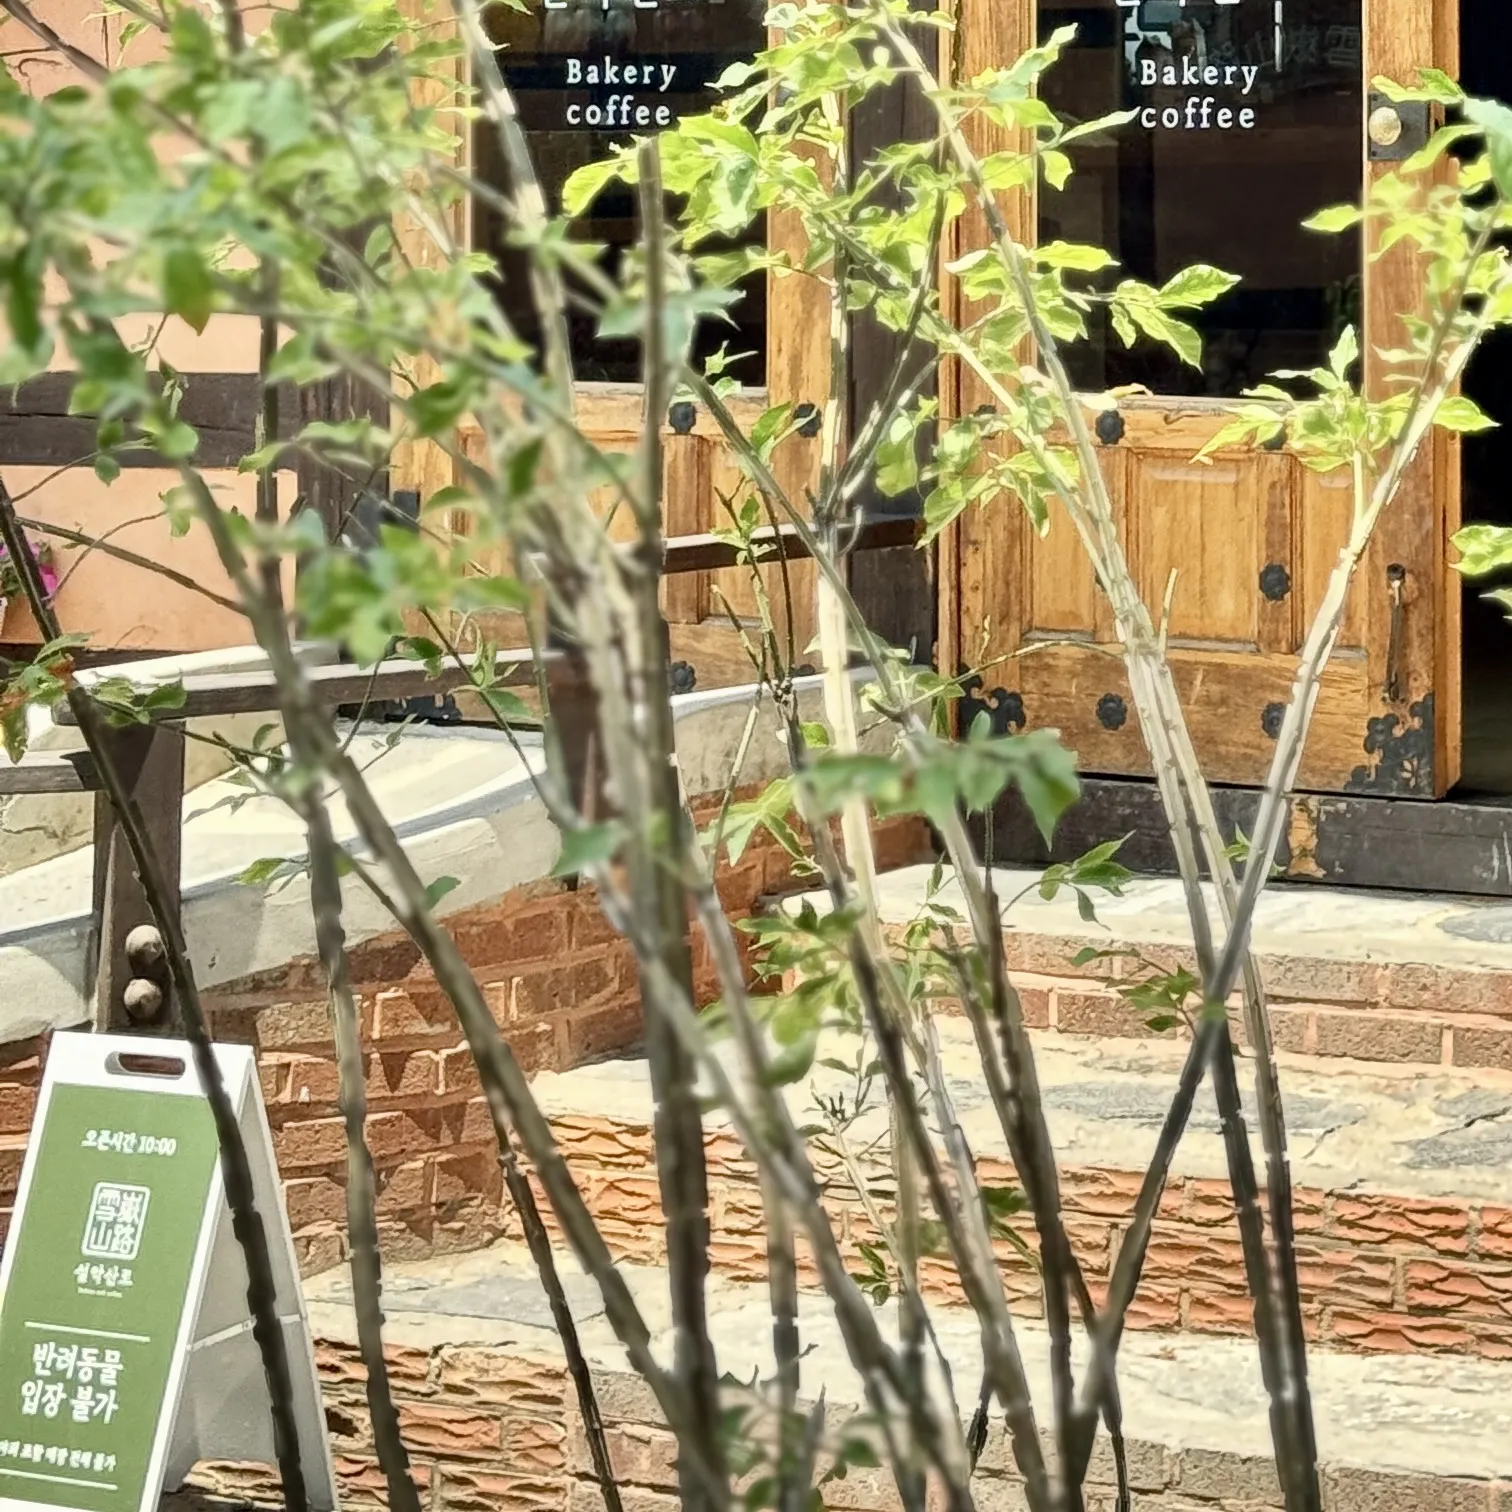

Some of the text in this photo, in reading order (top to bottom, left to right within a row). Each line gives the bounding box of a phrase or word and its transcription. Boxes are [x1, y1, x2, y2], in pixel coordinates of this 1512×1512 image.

[567, 56, 677, 92] Bakery
[1140, 56, 1259, 94] Bakery
[566, 95, 672, 126] coffee
[1141, 97, 1256, 129] coffee
[81, 1129, 177, 1156] 오픈시간 10:00
[73, 1262, 133, 1287] 설악산로
[33, 1341, 124, 1386] 반려동물
[21, 1379, 119, 1424] 입장 불가
